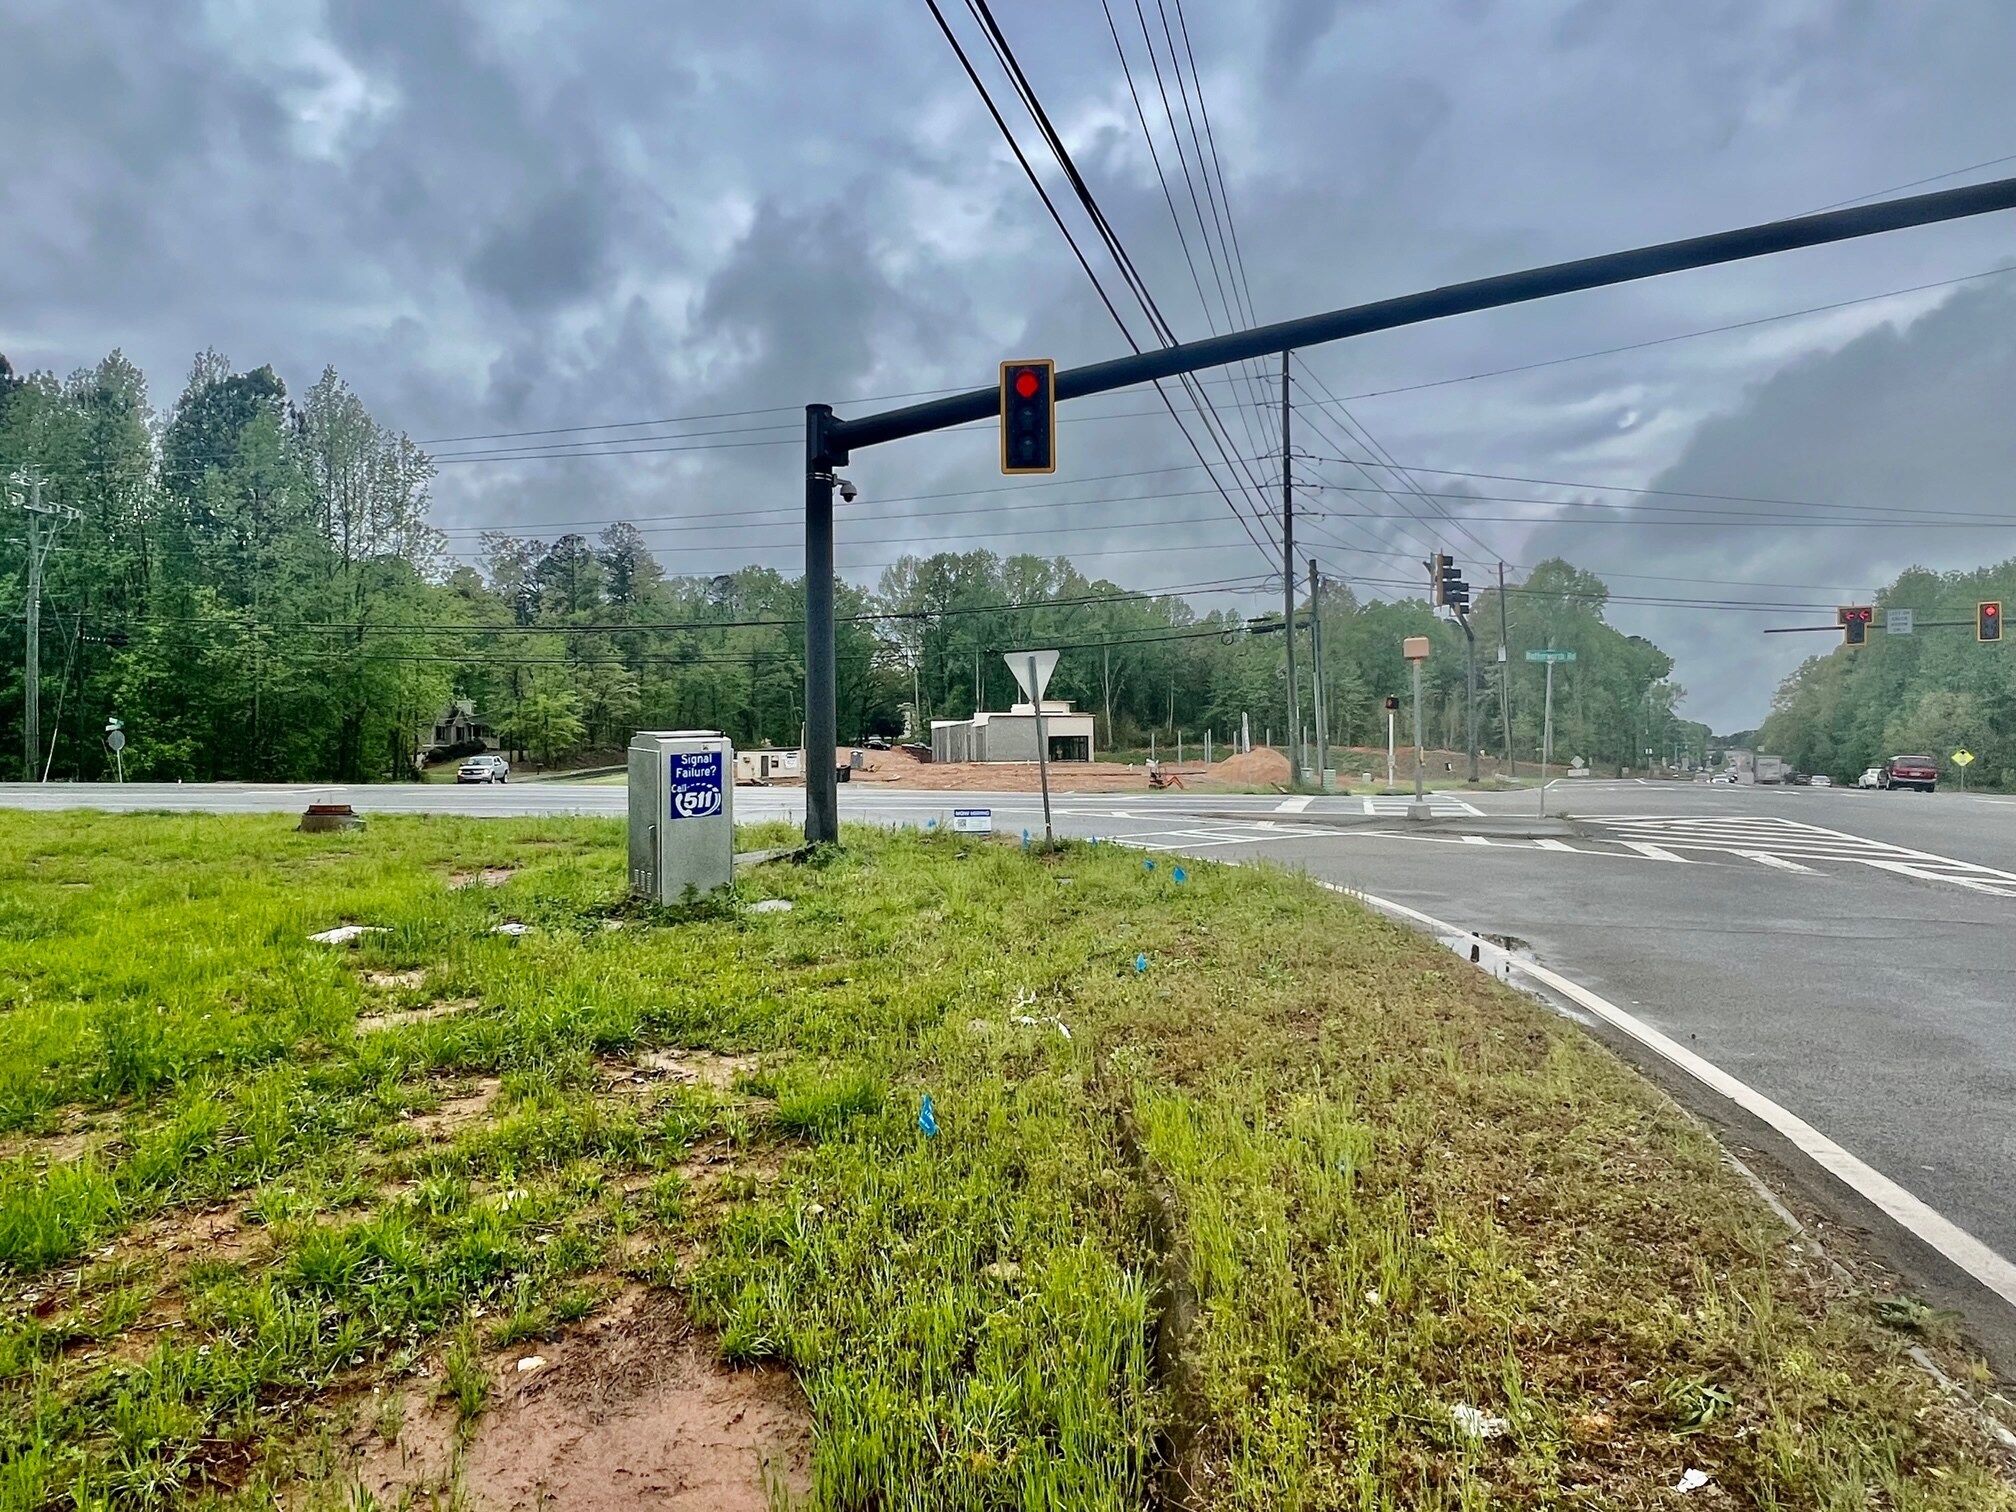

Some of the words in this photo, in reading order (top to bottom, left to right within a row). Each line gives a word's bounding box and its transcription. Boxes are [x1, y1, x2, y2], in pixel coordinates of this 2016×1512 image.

[681, 753, 713, 767] Signal
[676, 765, 717, 778] Failure?
[671, 783, 687, 793] Call
[684, 791, 713, 809] 511
